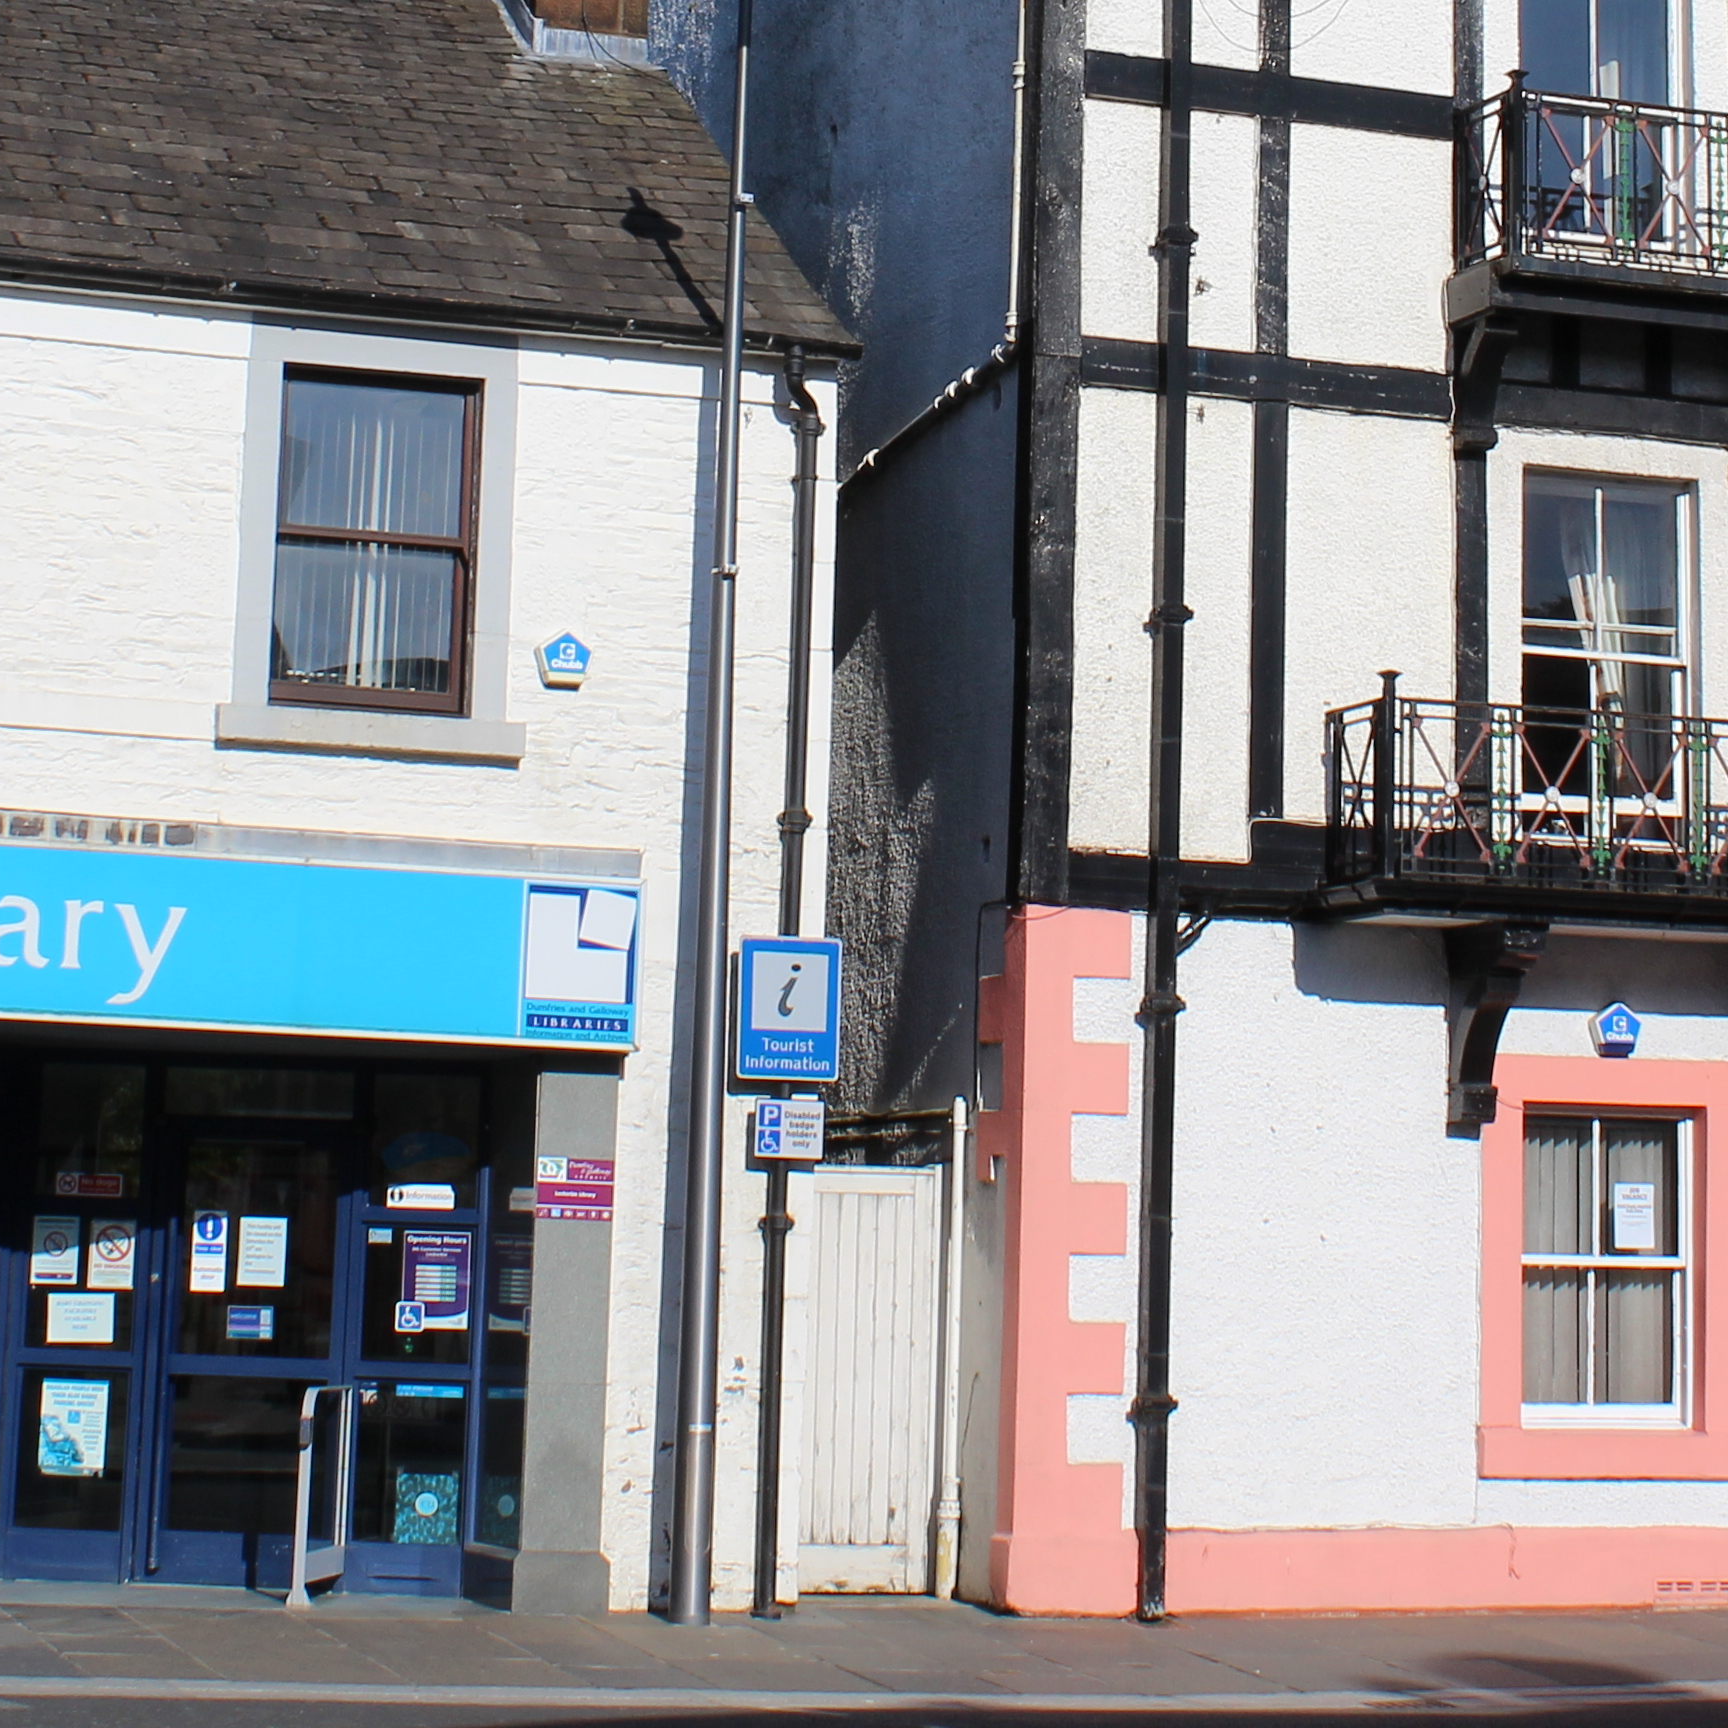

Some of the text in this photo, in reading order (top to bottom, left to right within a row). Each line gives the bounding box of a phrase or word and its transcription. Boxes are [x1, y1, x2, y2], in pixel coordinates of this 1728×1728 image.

[551, 658, 583, 670] Chubb
[526, 1002, 630, 1017] Dumfries and Galloway
[533, 1016, 622, 1030] LIBRARIES
[525, 1029, 572, 1038] Information
[761, 1037, 815, 1053] Tourist
[745, 1054, 830, 1072] Information
[763, 1106, 821, 1125] P Disabled
[789, 1120, 815, 1131] badge
[785, 1129, 818, 1140] holders
[792, 1139, 811, 1150] only
[406, 1190, 453, 1201] Information
[407, 1234, 467, 1245] Opening Hours
